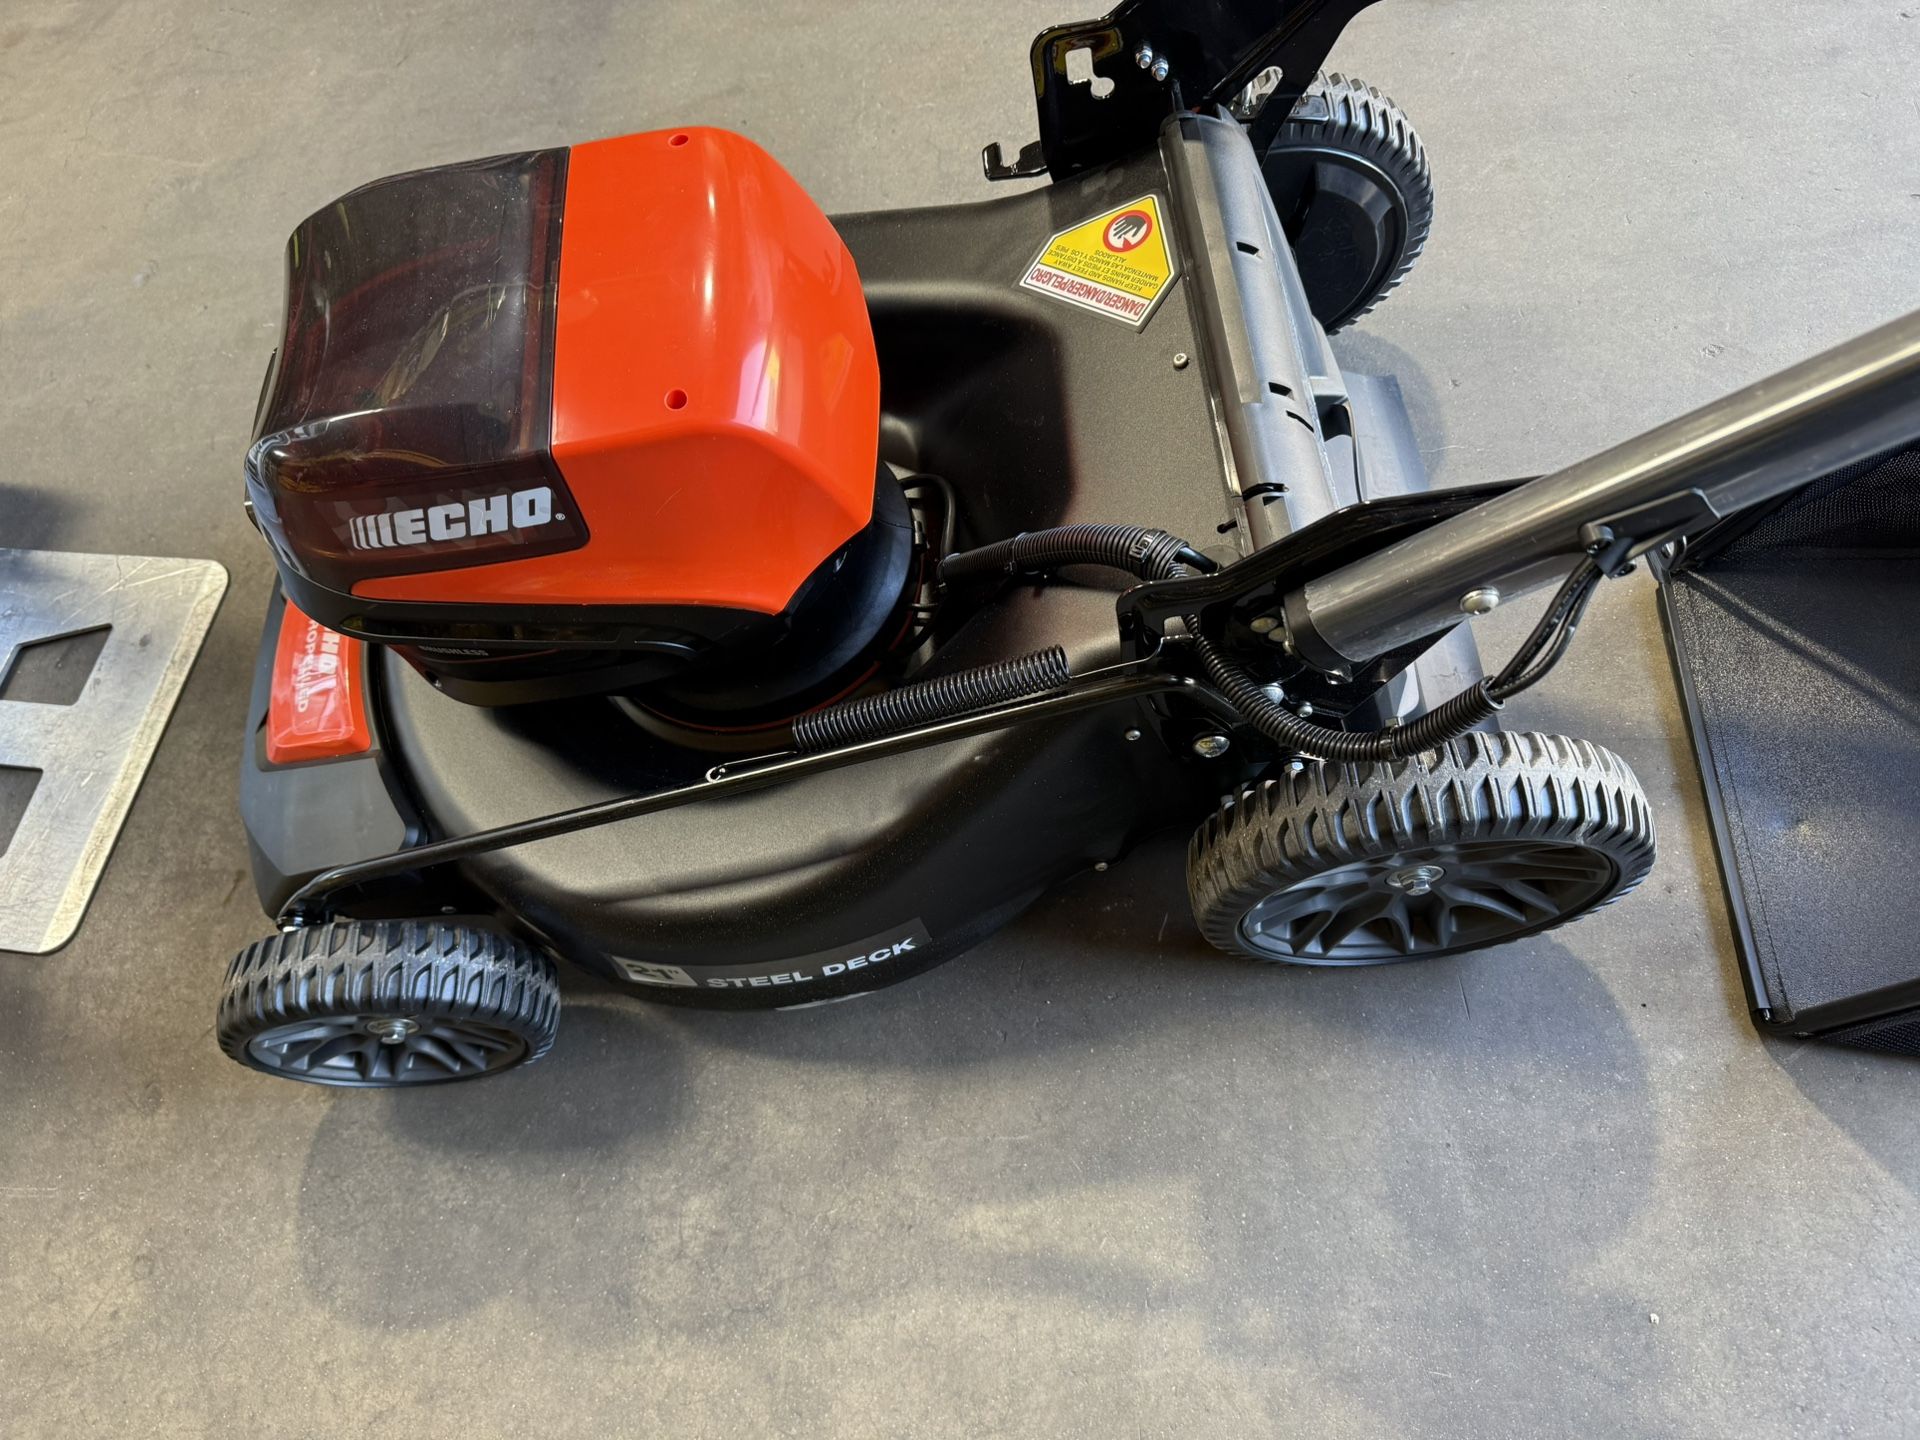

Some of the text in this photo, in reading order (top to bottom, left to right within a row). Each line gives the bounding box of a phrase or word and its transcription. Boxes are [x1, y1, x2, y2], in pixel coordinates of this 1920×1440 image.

[1048, 249, 1077, 263] DISTANCE
[1071, 249, 1084, 257] LOS
[1083, 261, 1102, 271] PIEDS
[1088, 255, 1111, 266] MANOS
[1111, 262, 1124, 270] LAS
[1055, 259, 1143, 292] KEEP HANDS AND FEET AWAY
[1102, 267, 1111, 275] ET
[1110, 269, 1131, 281] MAINS
[1124, 266, 1159, 282] MANTENGA
[1130, 275, 1158, 290] GARDER
[1030, 267, 1147, 316] DANGER/DANGER/PELIGRO
[392, 486, 553, 547] ECHO
[705, 971, 813, 989] STEEL
[821, 936, 917, 977] DECK
